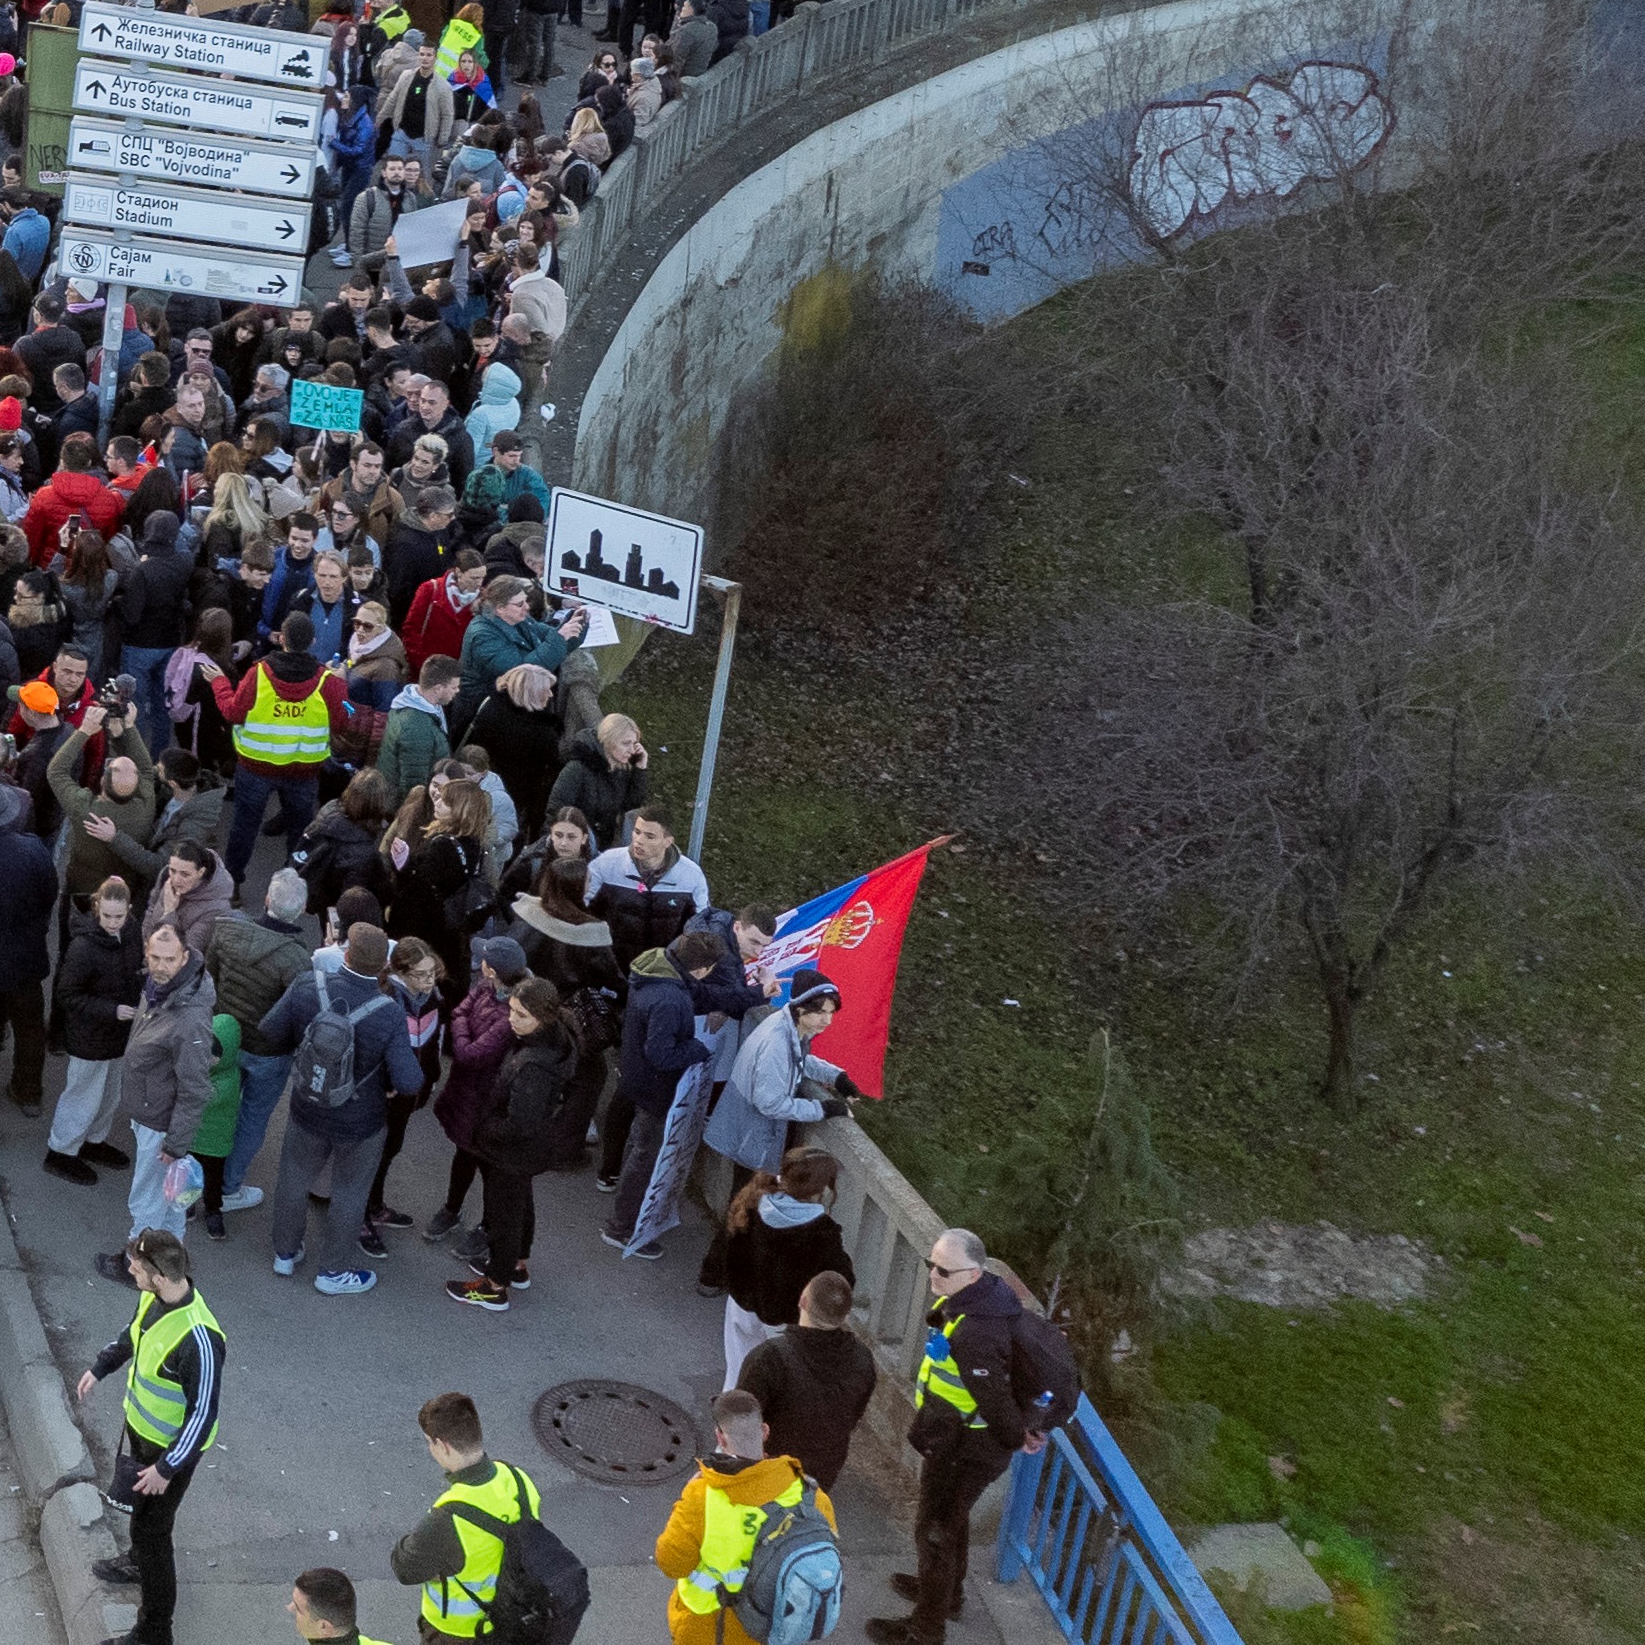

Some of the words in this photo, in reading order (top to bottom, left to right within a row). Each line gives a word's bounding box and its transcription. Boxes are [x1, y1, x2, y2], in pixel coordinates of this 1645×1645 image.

[117, 17, 207, 46] Железничка
[210, 31, 271, 55] станица
[114, 35, 172, 62] Railway
[175, 43, 225, 64] Station
[109, 93, 137, 111] Bus
[140, 97, 191, 117] Station
[112, 75, 189, 104] Аутобуска
[192, 88, 253, 110] станица
[121, 134, 153, 151] СПЦ
[158, 138, 250, 163] "Војводина"
[119, 151, 152, 169] SBC
[155, 156, 240, 181] "Vojvodina"
[117, 191, 179, 212] Стадион
[115, 208, 173, 228] Stadium
[110, 246, 152, 266] Сајам
[108, 261, 136, 279] Fair
